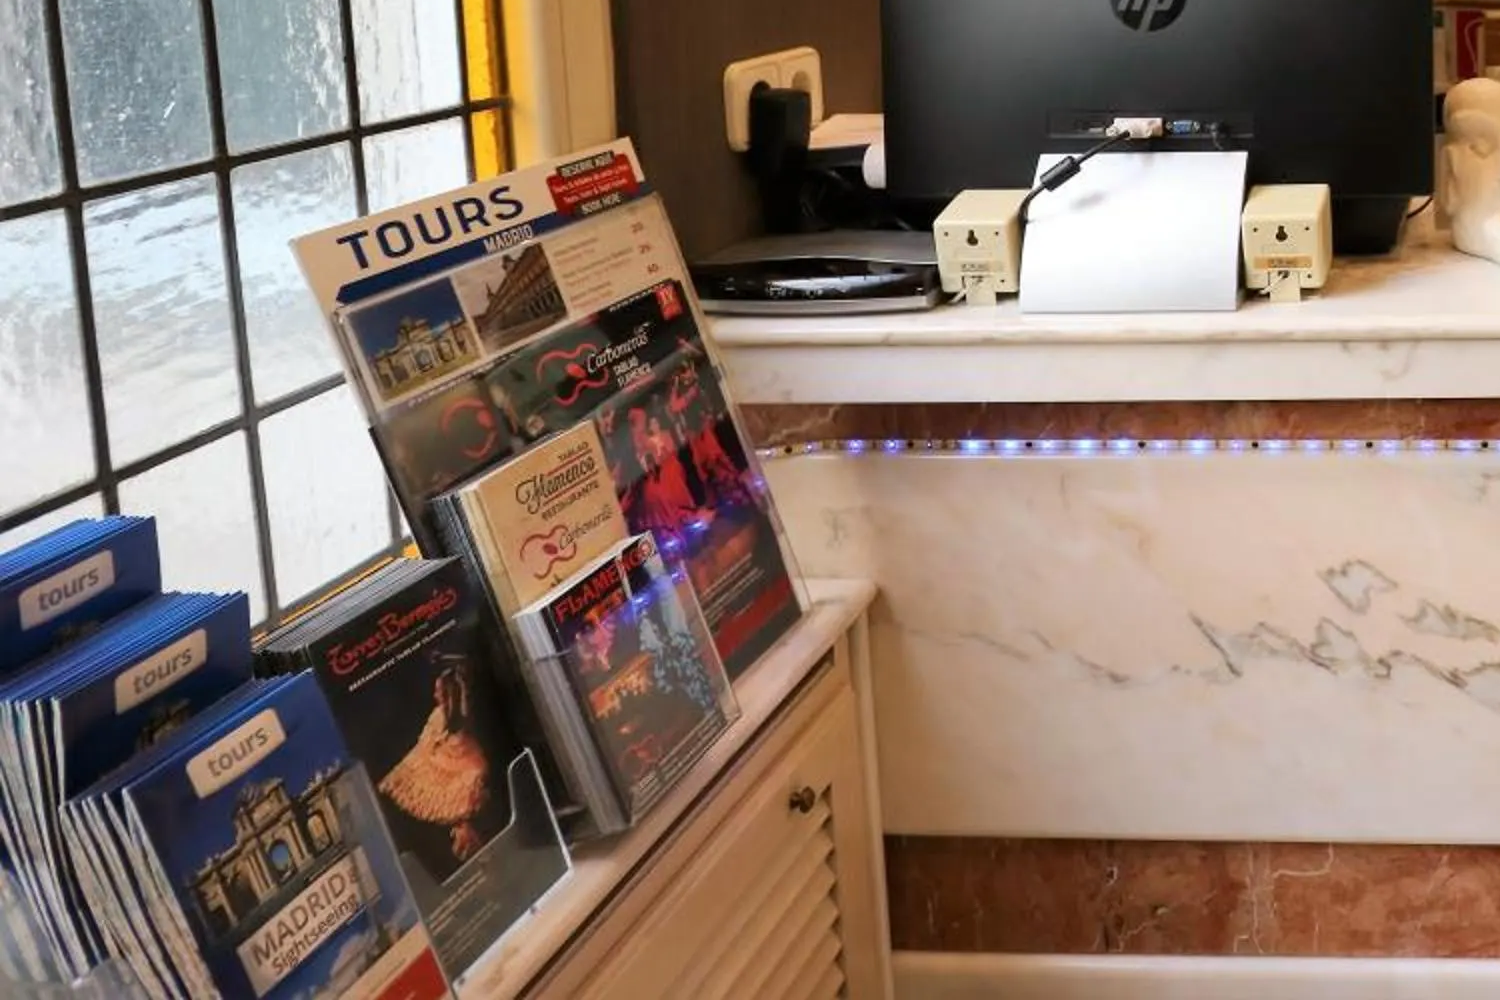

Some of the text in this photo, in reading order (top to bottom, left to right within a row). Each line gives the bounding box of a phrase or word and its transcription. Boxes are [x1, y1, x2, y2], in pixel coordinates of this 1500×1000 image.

[336, 185, 524, 269] TOURS
[483, 224, 533, 253] MADRID
[37, 567, 99, 611] tours
[132, 648, 193, 695] tours
[207, 727, 269, 777] tours
[252, 873, 346, 966] MADRID
[272, 894, 358, 976] Sightseeing
